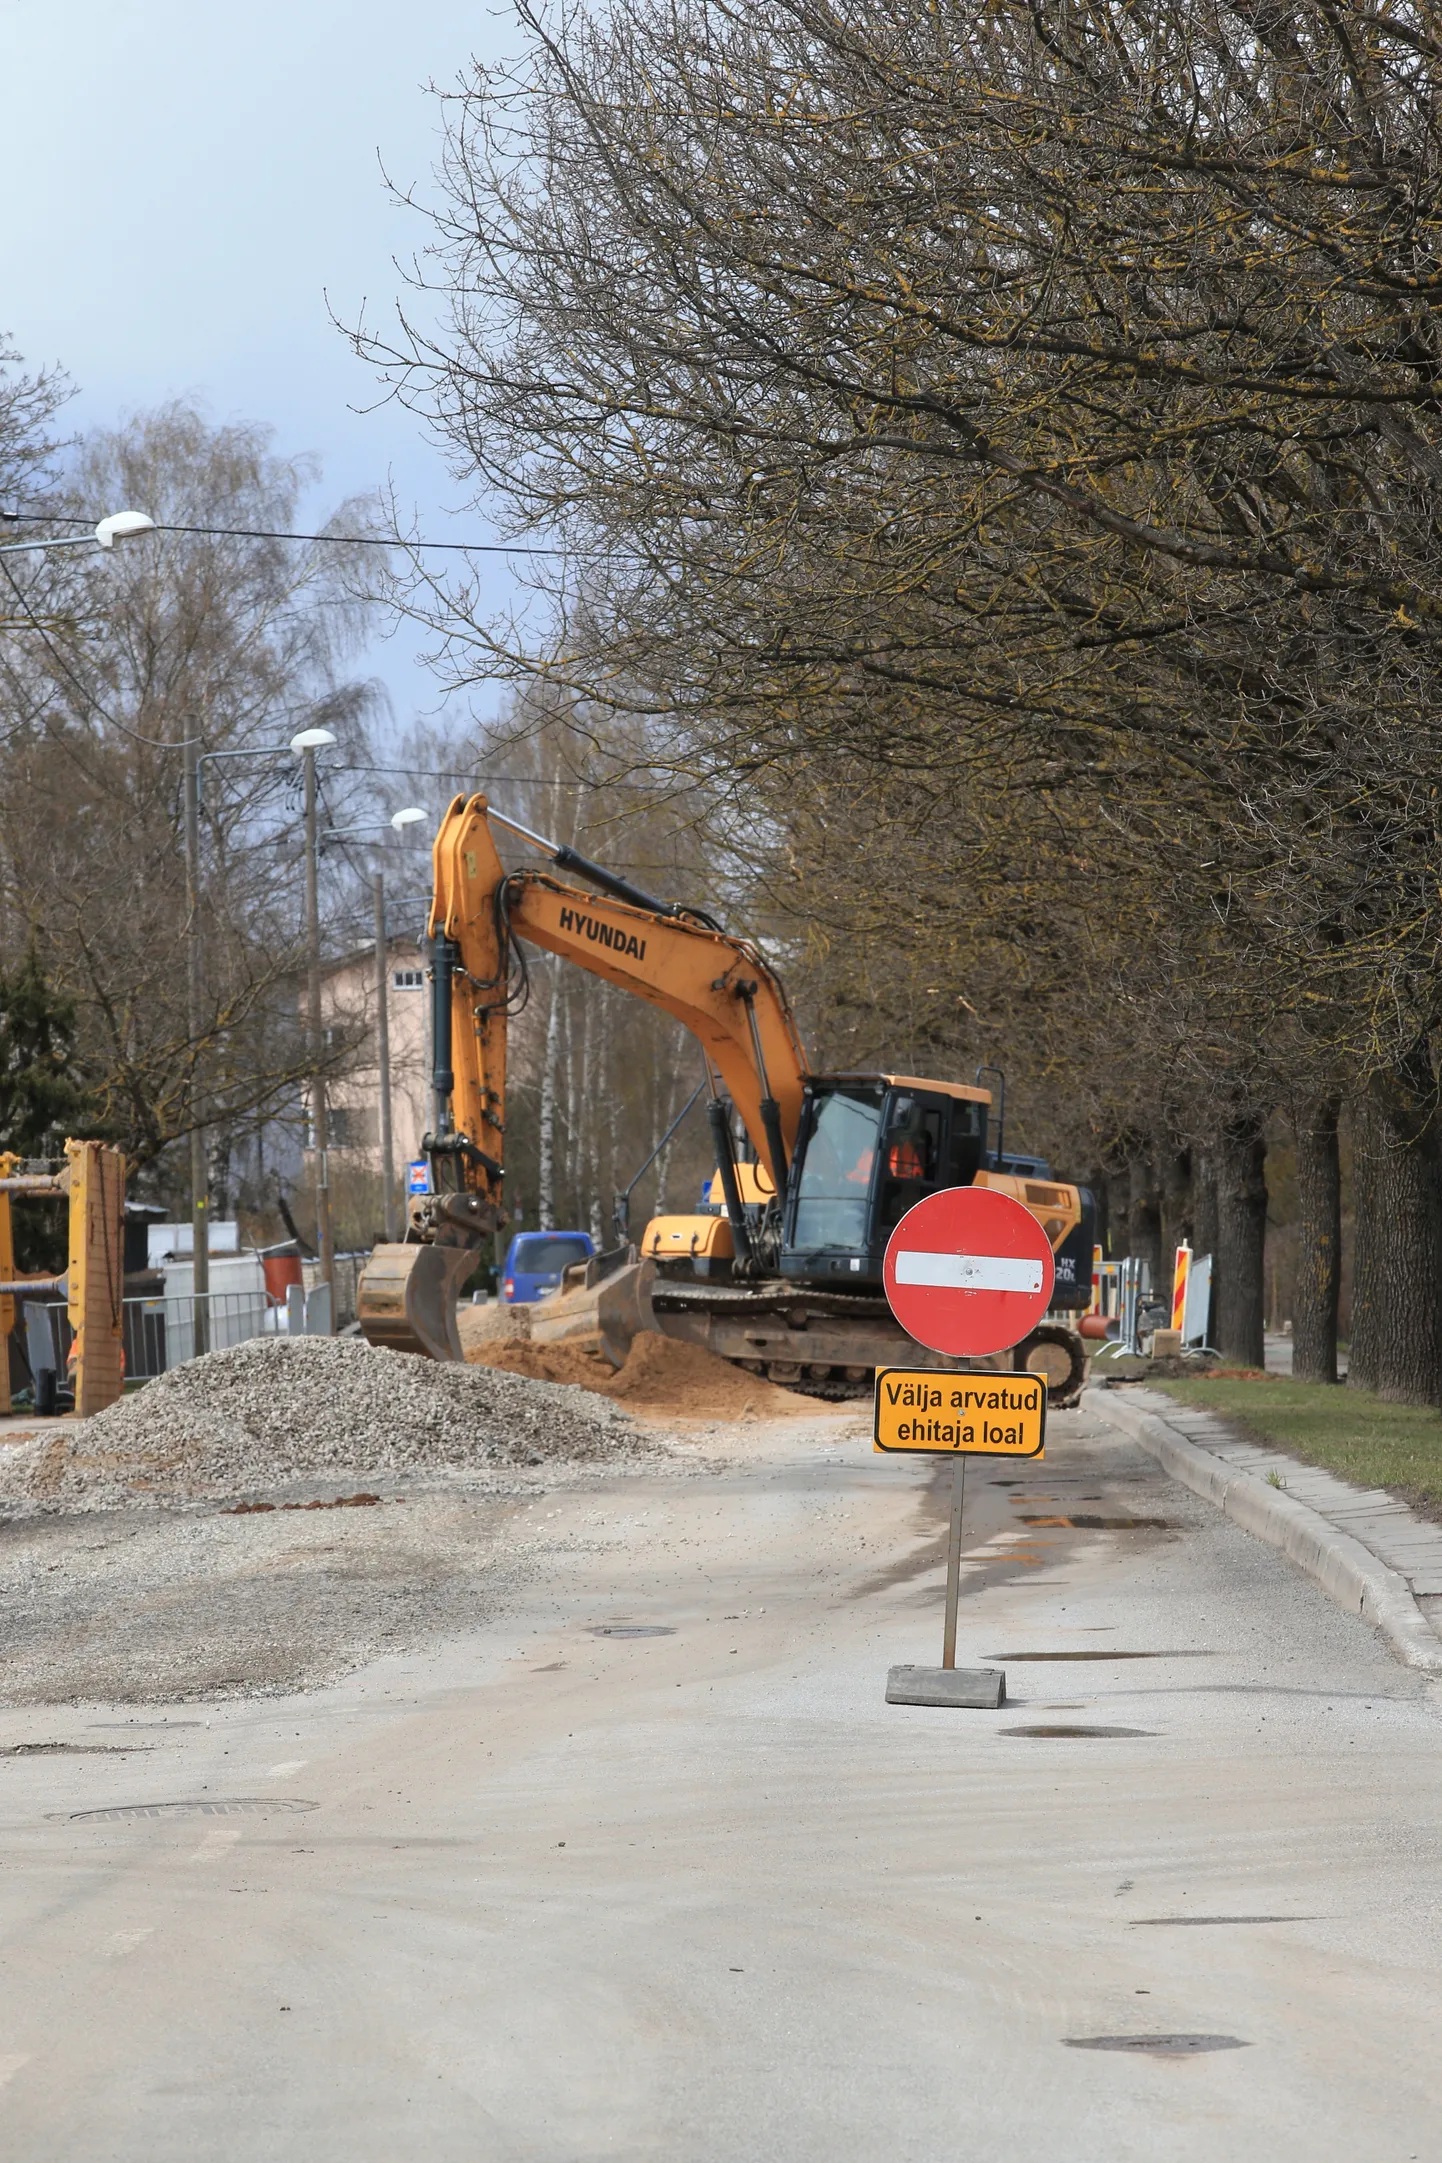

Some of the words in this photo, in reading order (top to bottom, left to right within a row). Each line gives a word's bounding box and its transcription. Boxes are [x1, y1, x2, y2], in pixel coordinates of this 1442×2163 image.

[559, 907, 646, 961] HYUNDAI
[1061, 1257, 1076, 1269] HX
[885, 1383, 942, 1413] Välja
[950, 1388, 1038, 1411] arvatud
[897, 1418, 975, 1448] ehitaja
[983, 1421, 1024, 1445] loal
